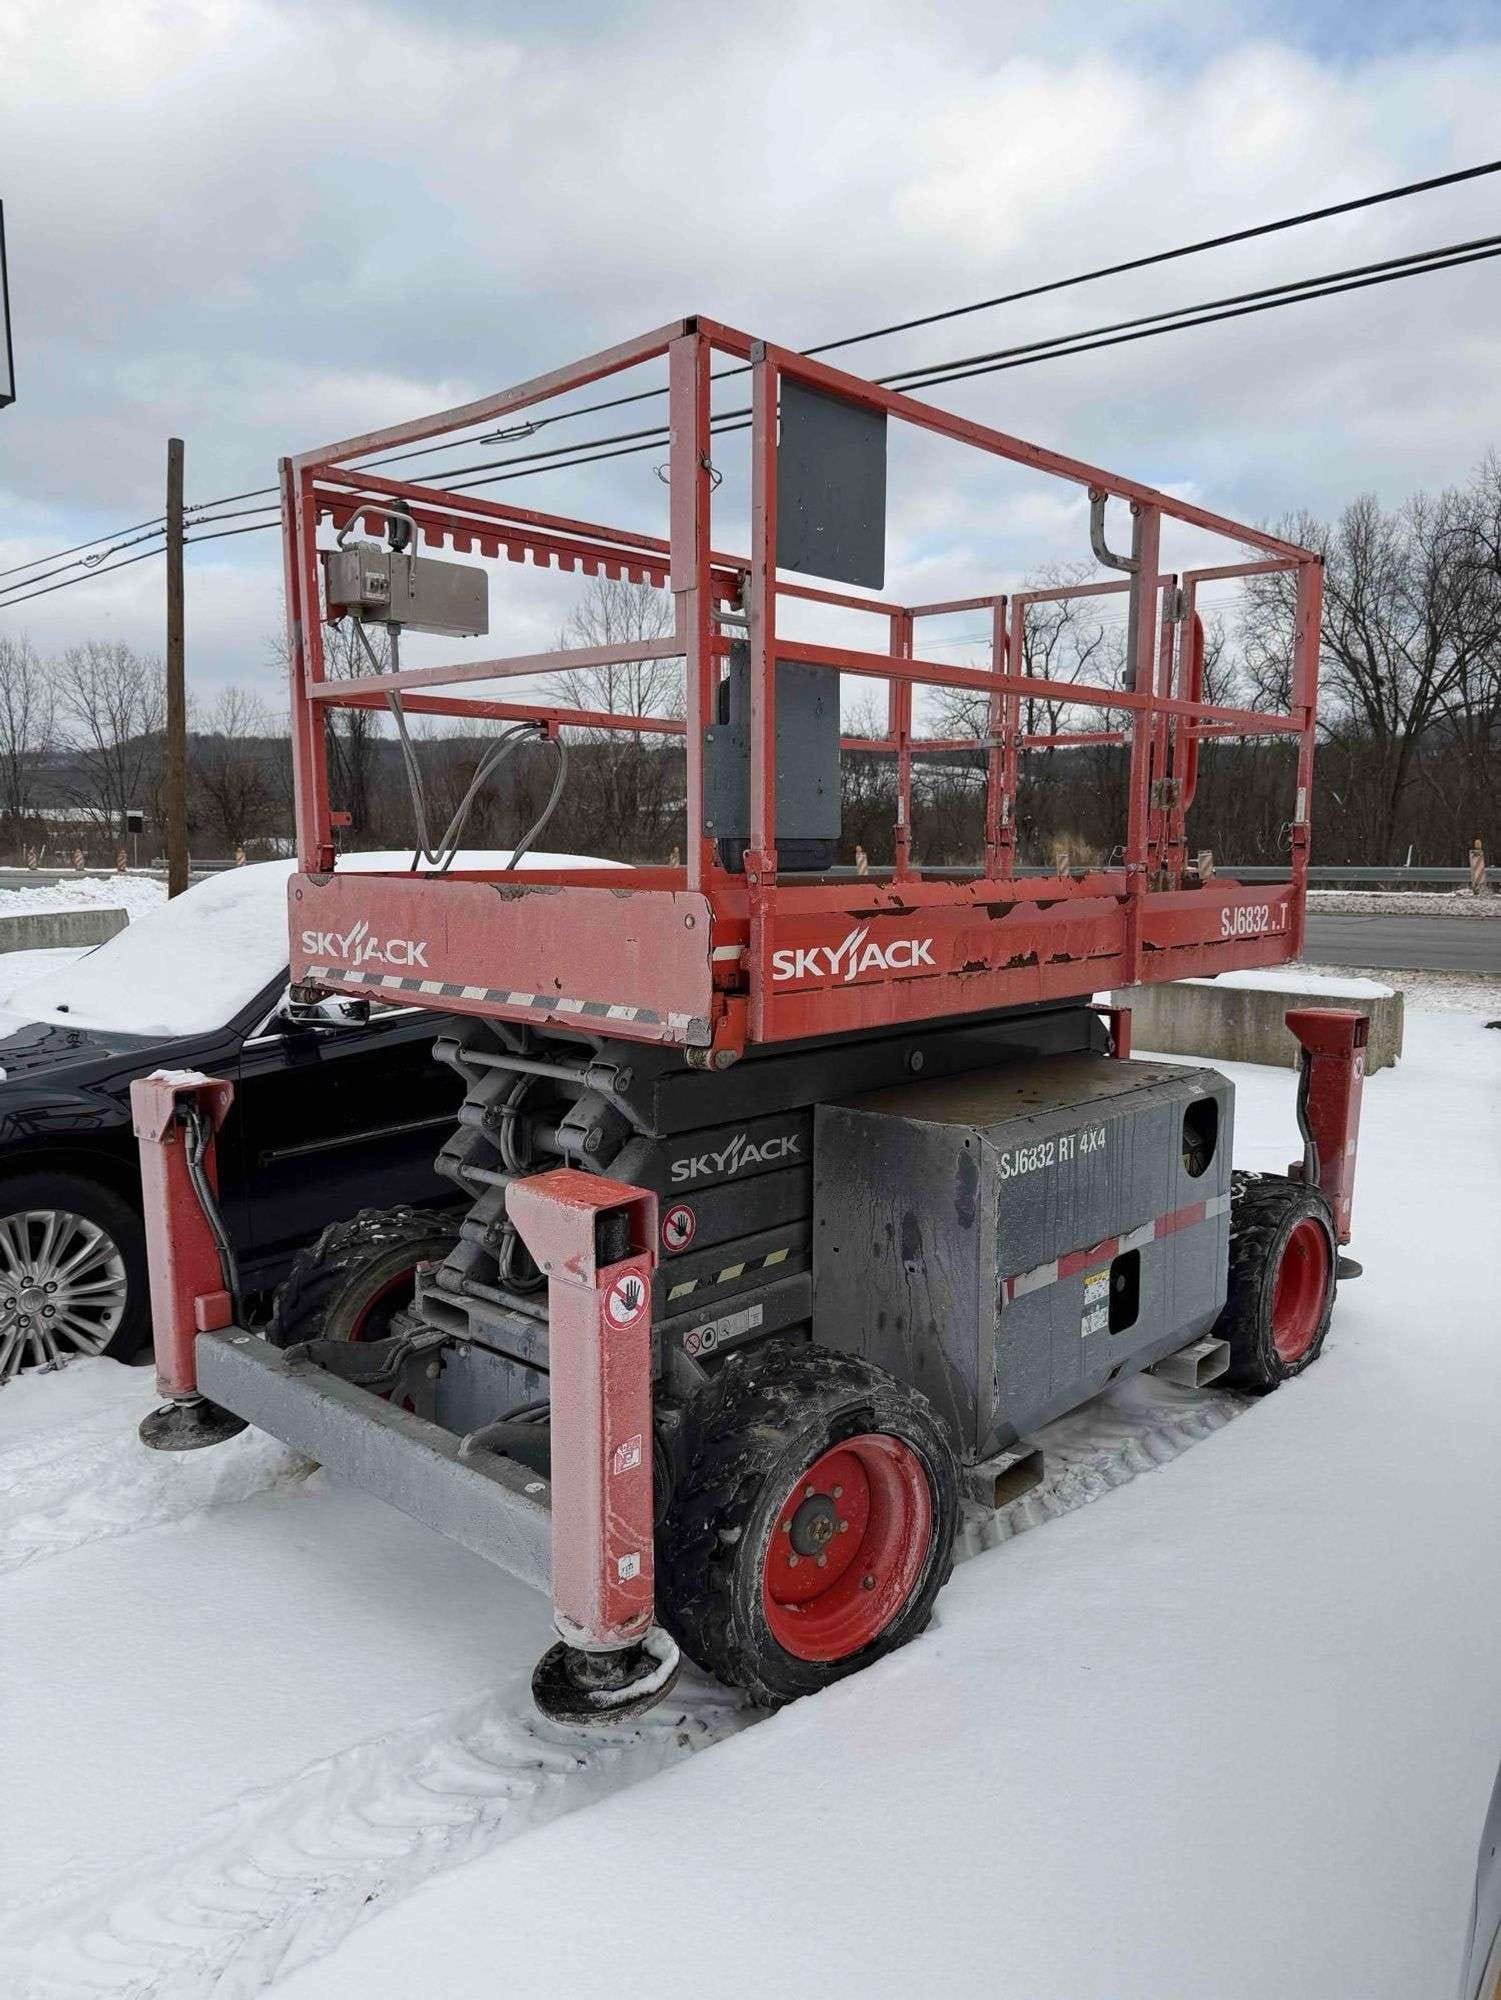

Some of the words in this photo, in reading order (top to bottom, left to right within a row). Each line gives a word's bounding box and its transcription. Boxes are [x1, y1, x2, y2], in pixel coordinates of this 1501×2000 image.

[302, 920, 428, 967] SKYJACK
[1221, 905, 1268, 936] SJ6832
[1271, 903, 1288, 930] T
[772, 926, 936, 981] SKYJACK
[671, 1133, 800, 1181] SKYJACK
[1000, 1142, 1054, 1179] SJ6832
[1059, 1134, 1076, 1162] RT
[1080, 1128, 1106, 1153] 4X4
